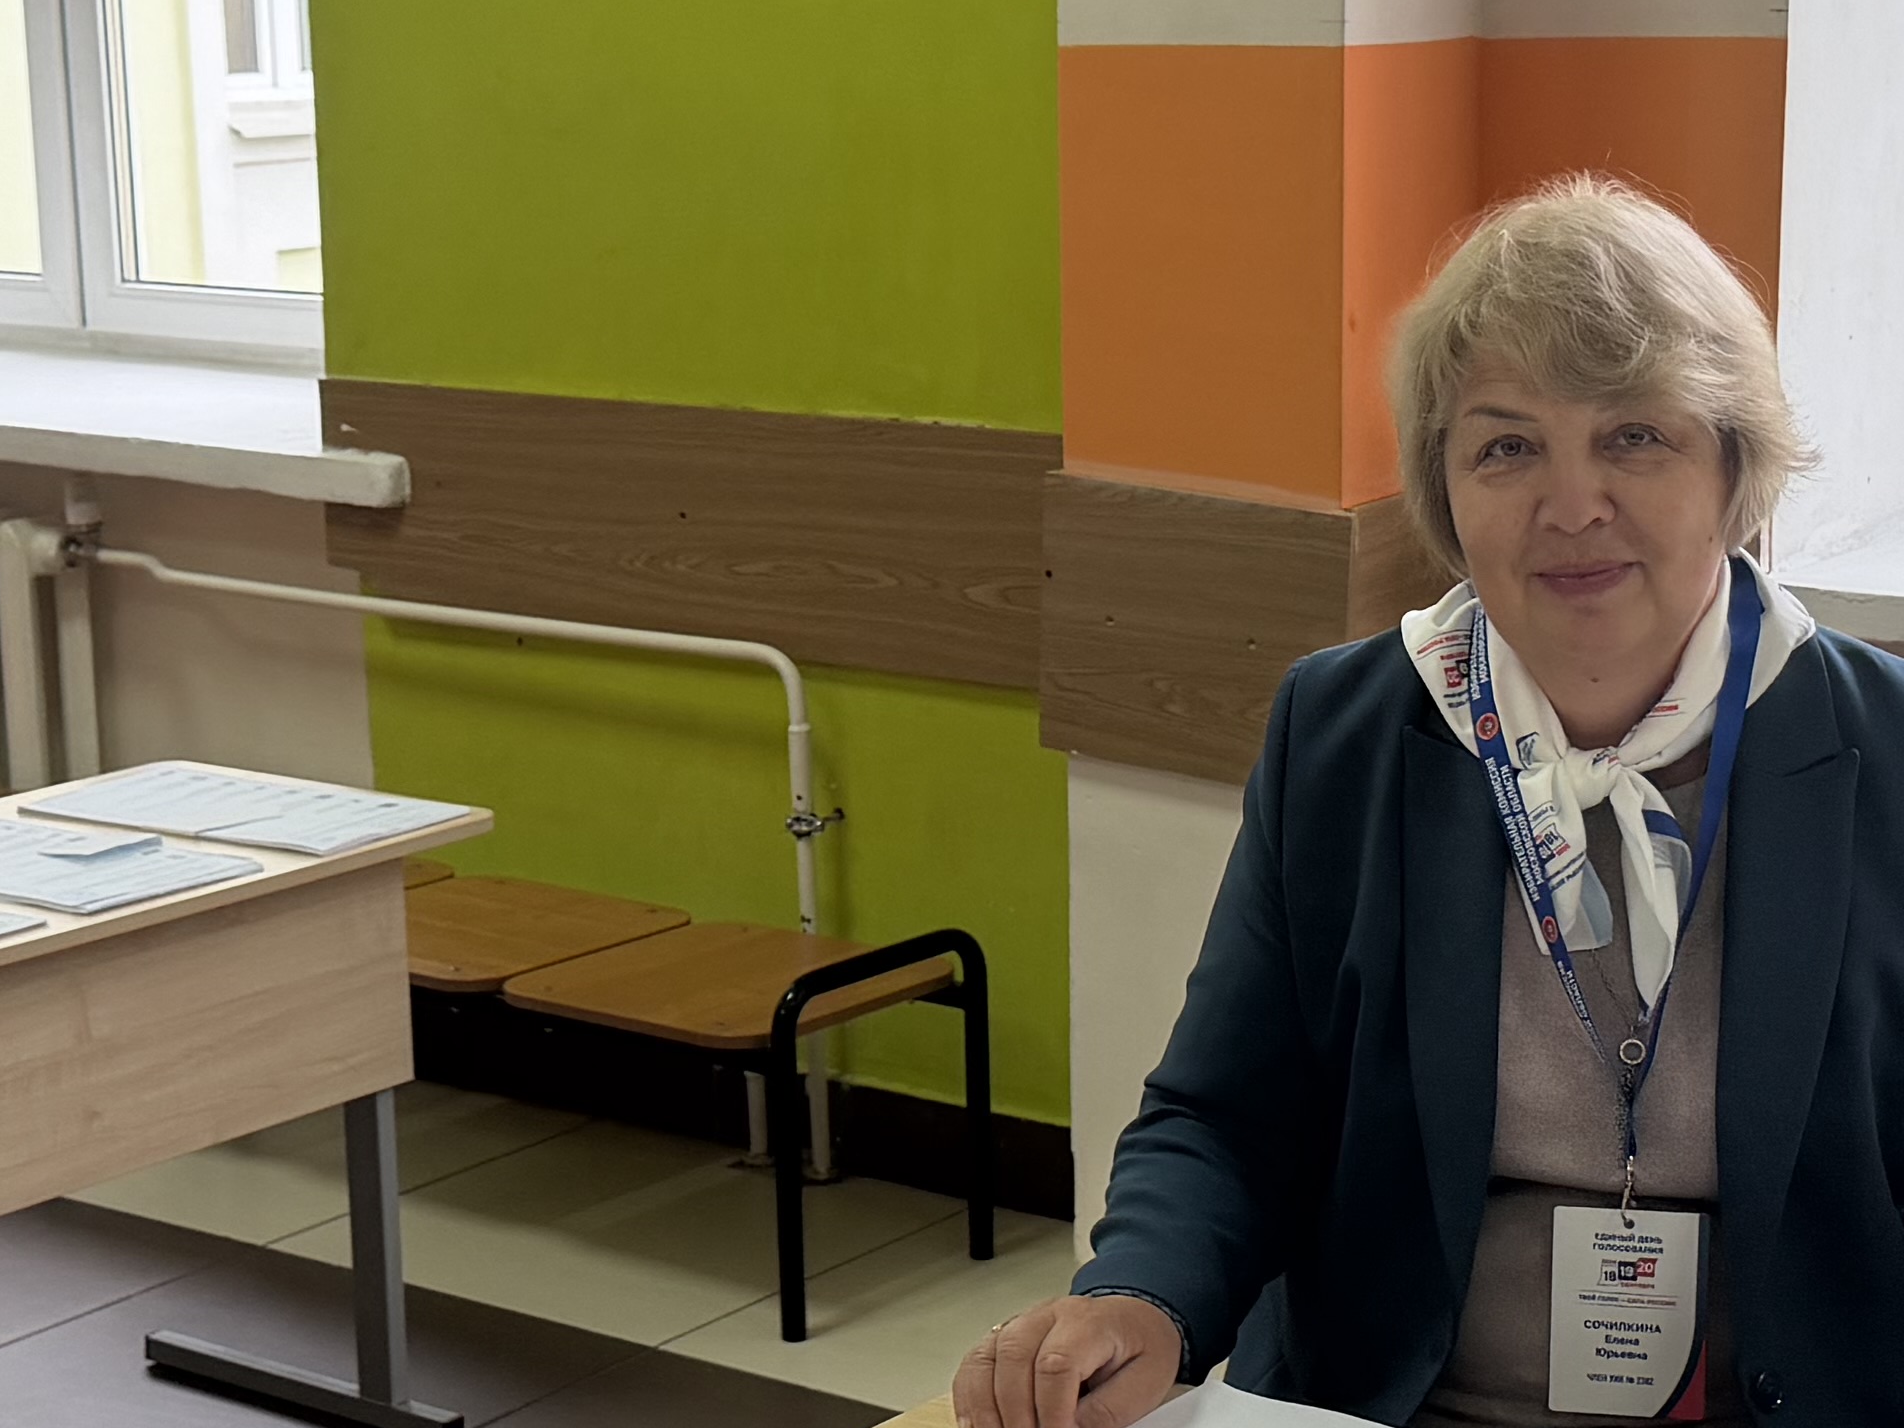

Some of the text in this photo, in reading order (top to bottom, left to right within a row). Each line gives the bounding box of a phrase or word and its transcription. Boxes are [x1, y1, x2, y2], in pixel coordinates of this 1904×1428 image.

[1500, 764, 1522, 813] ОБЛАСТИ
[1484, 756, 1541, 903] ИЗБИРАТЕЛЬНАЯ КОМИССИЯ
[1603, 1270, 1617, 1282] 18
[1637, 1262, 1653, 1273] 20
[1604, 1334, 1641, 1346] Елена
